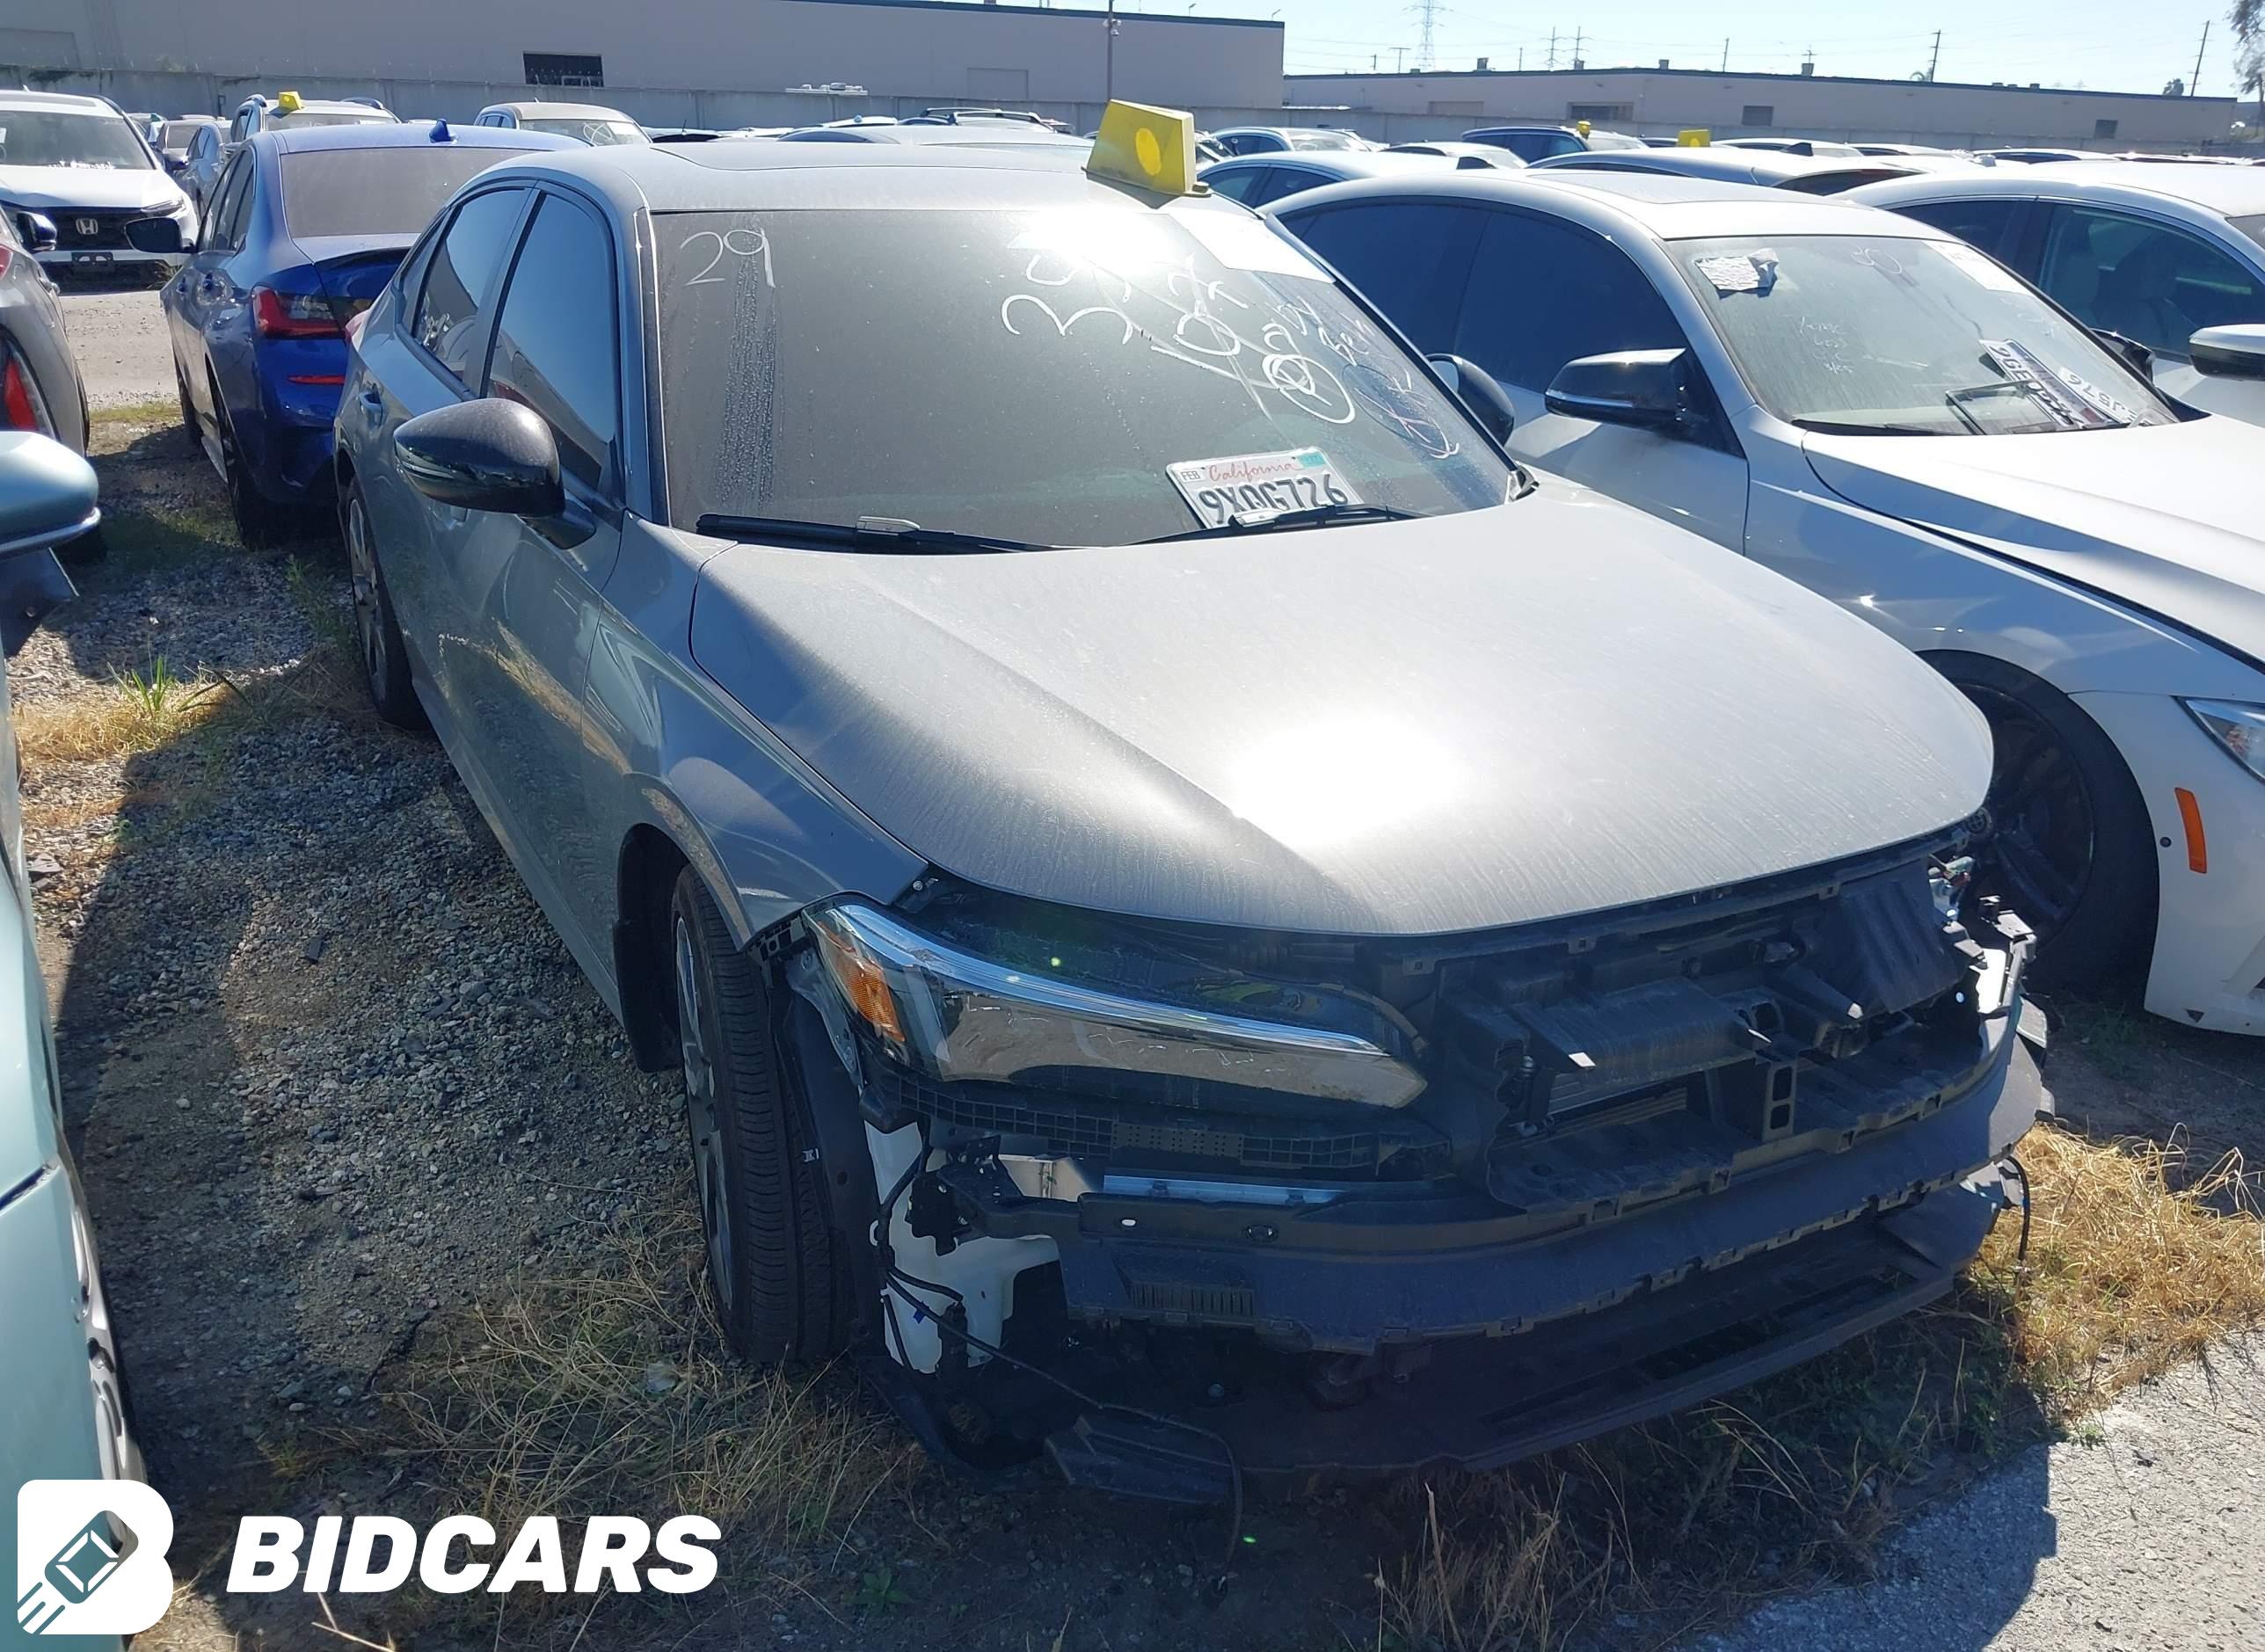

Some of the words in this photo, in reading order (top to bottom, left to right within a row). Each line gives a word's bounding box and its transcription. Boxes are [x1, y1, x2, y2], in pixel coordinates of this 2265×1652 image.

[679, 228, 776, 288] 29
[1180, 469, 1201, 481] FEB
[1208, 462, 1303, 484] California
[1198, 473, 1349, 525] 9XQG726
